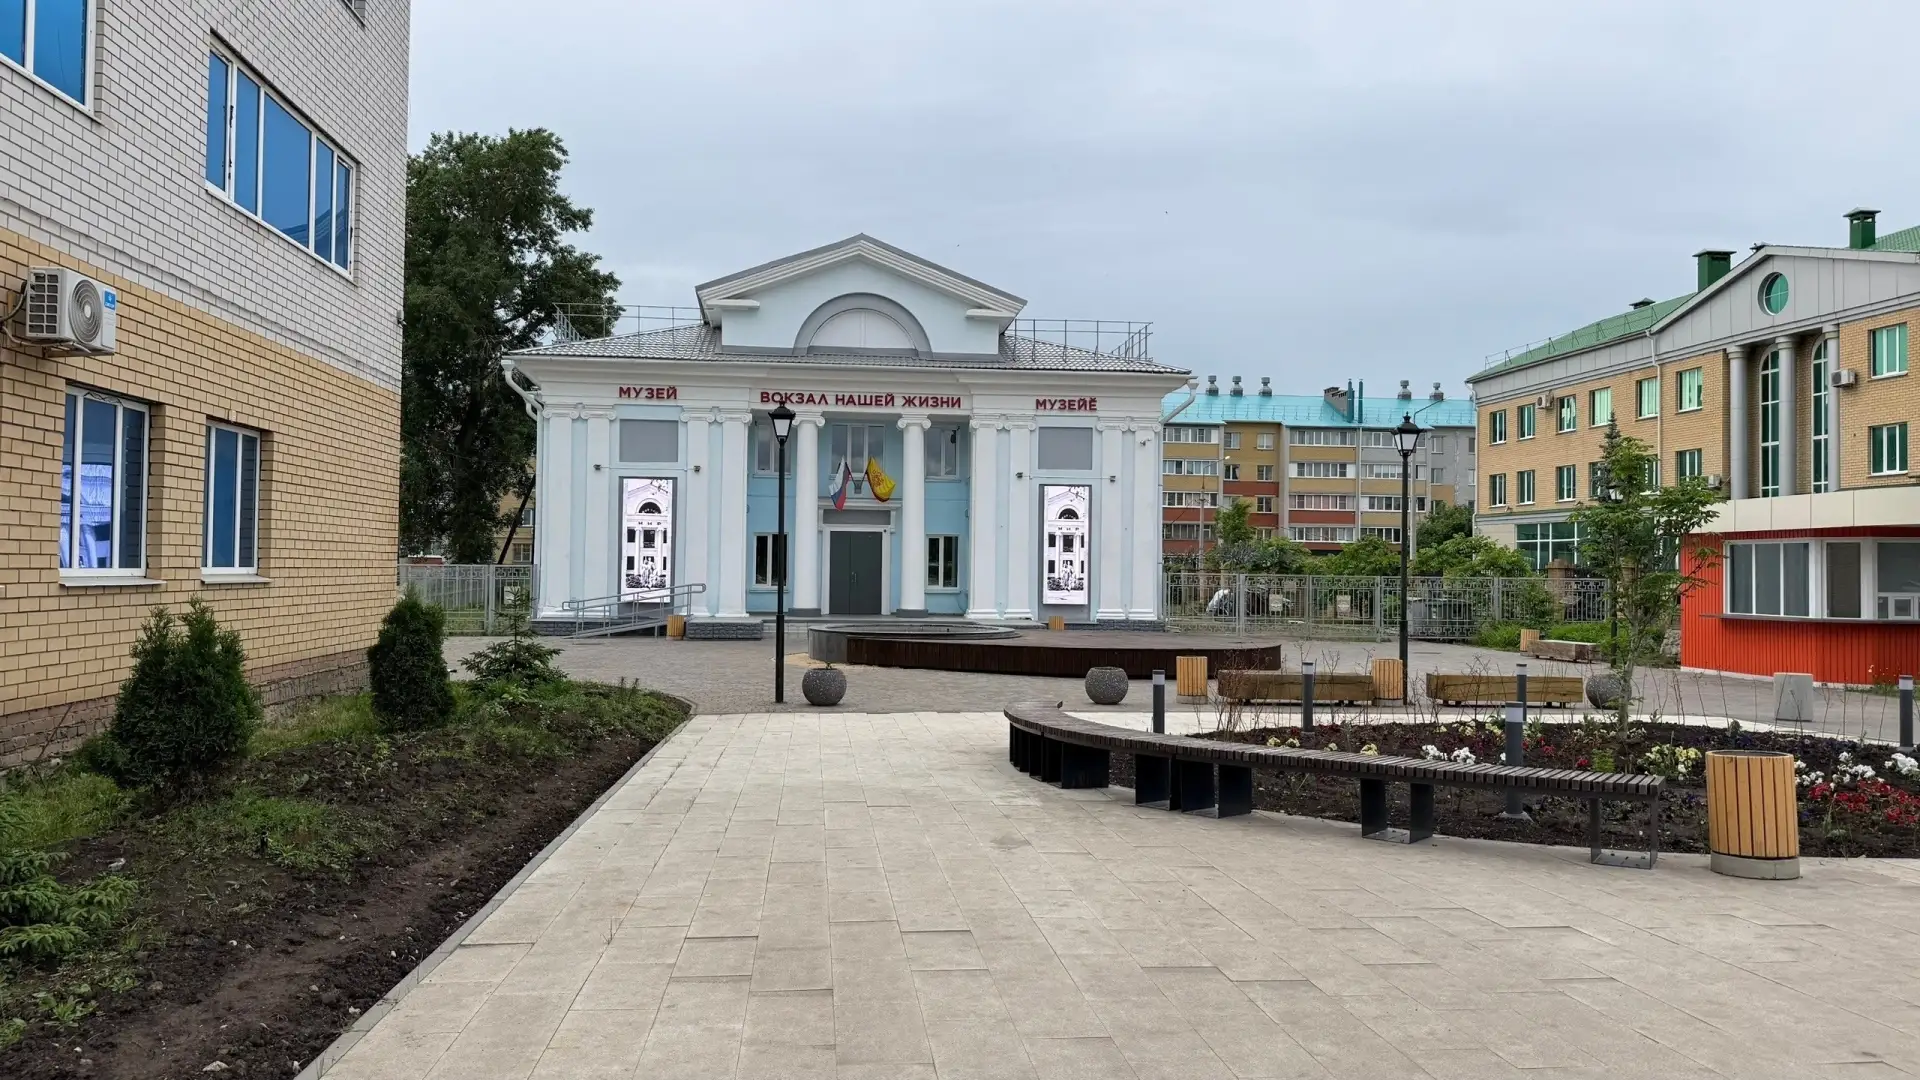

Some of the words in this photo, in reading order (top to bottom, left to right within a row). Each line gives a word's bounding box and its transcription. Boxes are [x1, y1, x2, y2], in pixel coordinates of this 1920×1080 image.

[619, 385, 677, 400] МУЗЕЙ
[760, 391, 829, 406] ВОКЗАЛ
[835, 392, 895, 407] НАШЕЙ
[902, 395, 961, 409] ЖИЗНИ
